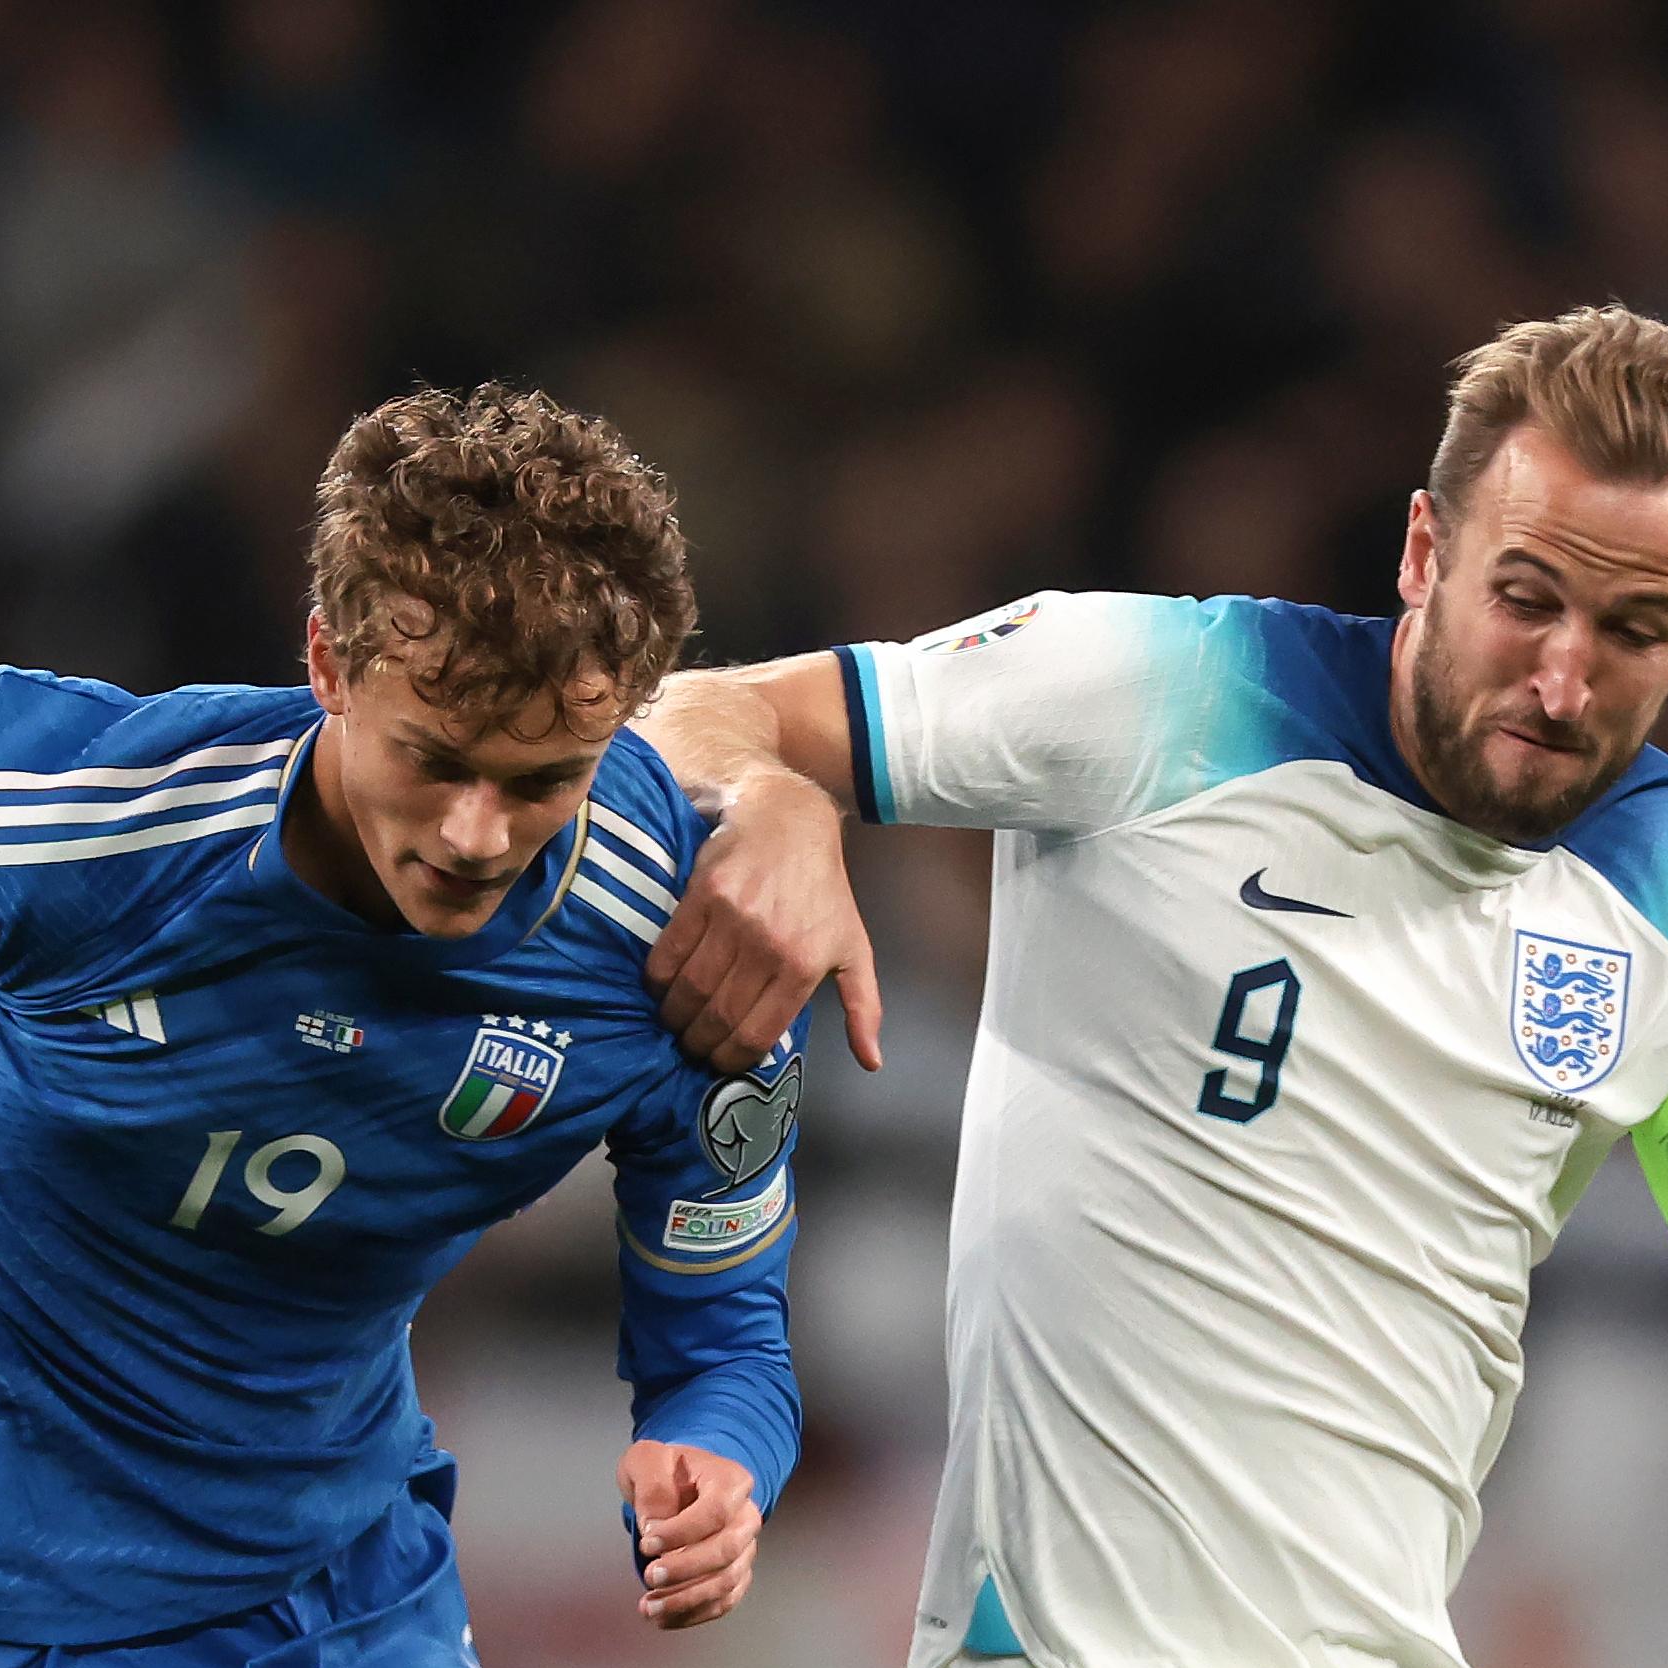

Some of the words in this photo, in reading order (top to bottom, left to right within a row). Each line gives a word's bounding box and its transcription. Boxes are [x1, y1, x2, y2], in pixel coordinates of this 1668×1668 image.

[476, 1039, 550, 1085] ITALIA
[1195, 955, 1303, 1126] 9
[170, 1130, 347, 1236] 19
[673, 1204, 713, 1217] UEFA
